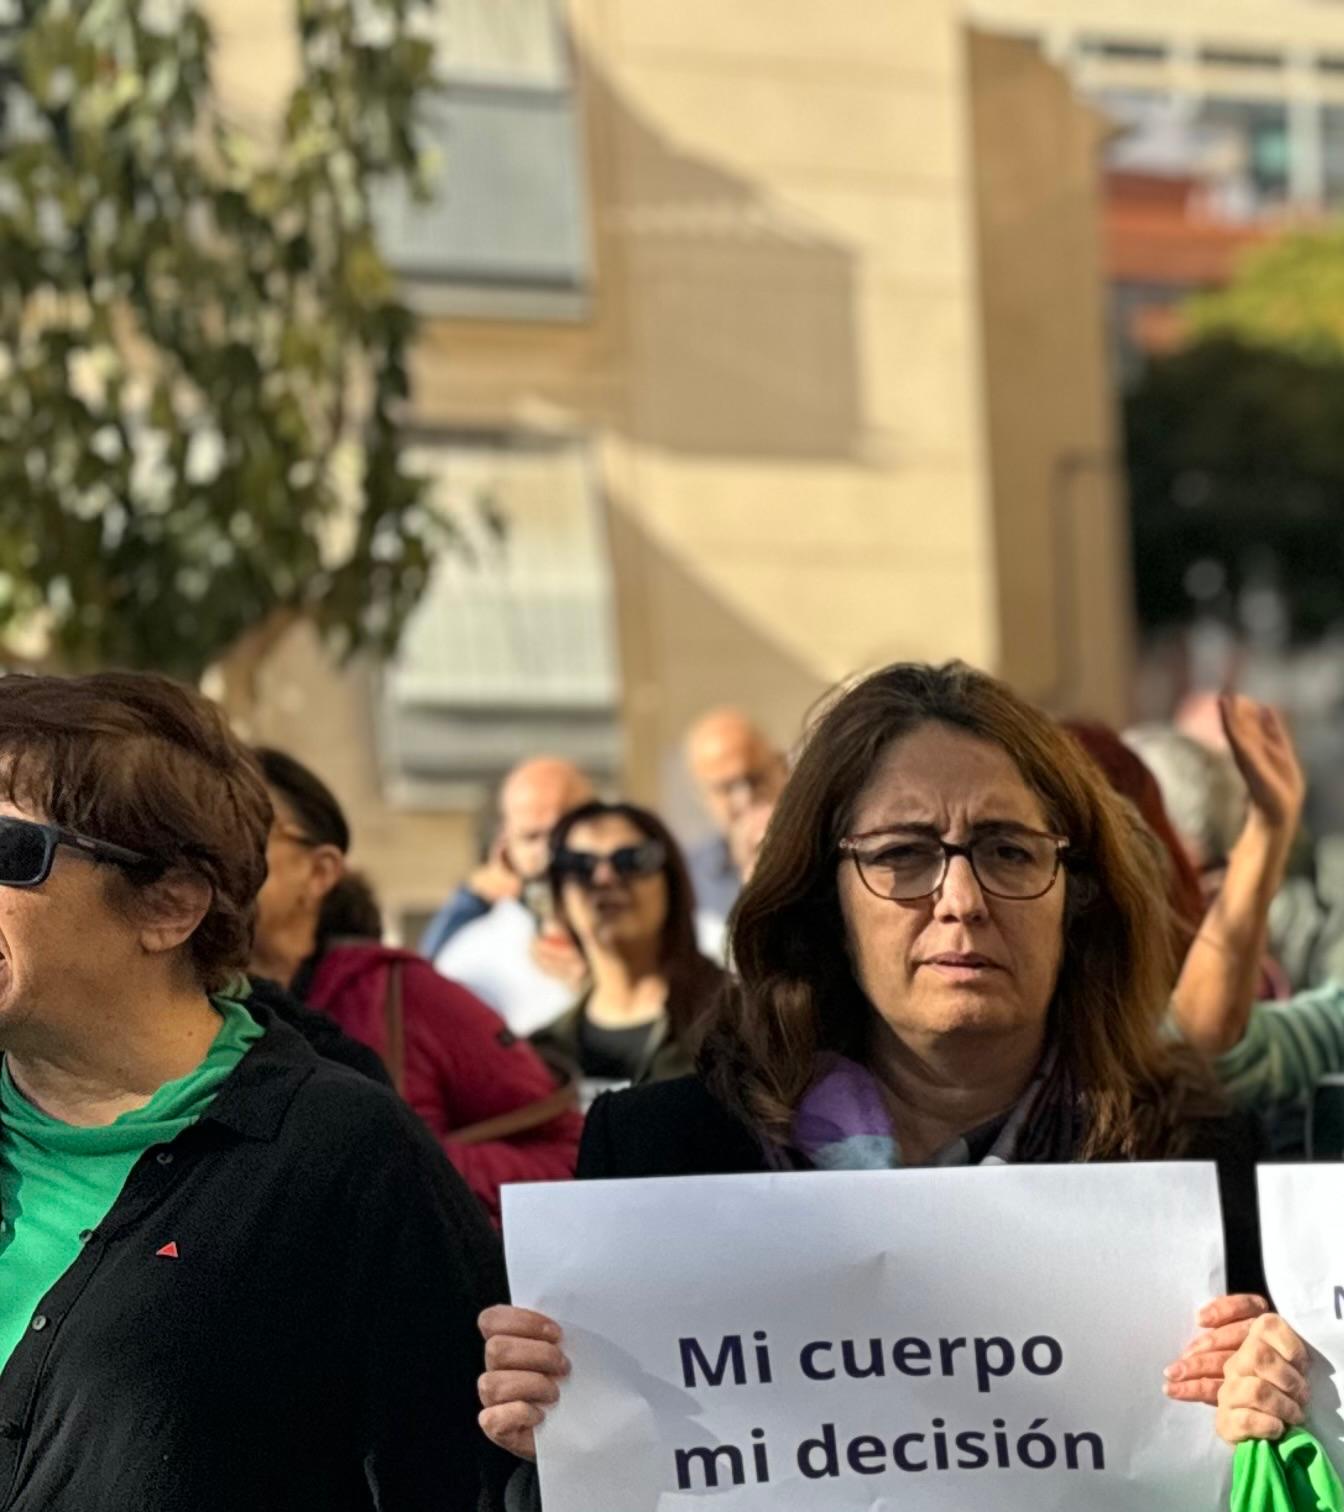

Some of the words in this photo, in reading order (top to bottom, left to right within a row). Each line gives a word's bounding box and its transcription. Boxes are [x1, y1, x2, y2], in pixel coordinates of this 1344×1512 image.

[679, 1331, 772, 1388] Mi
[800, 1335, 1063, 1392] cuerpo
[675, 1428, 769, 1490] mi
[797, 1418, 1105, 1479] decisión
